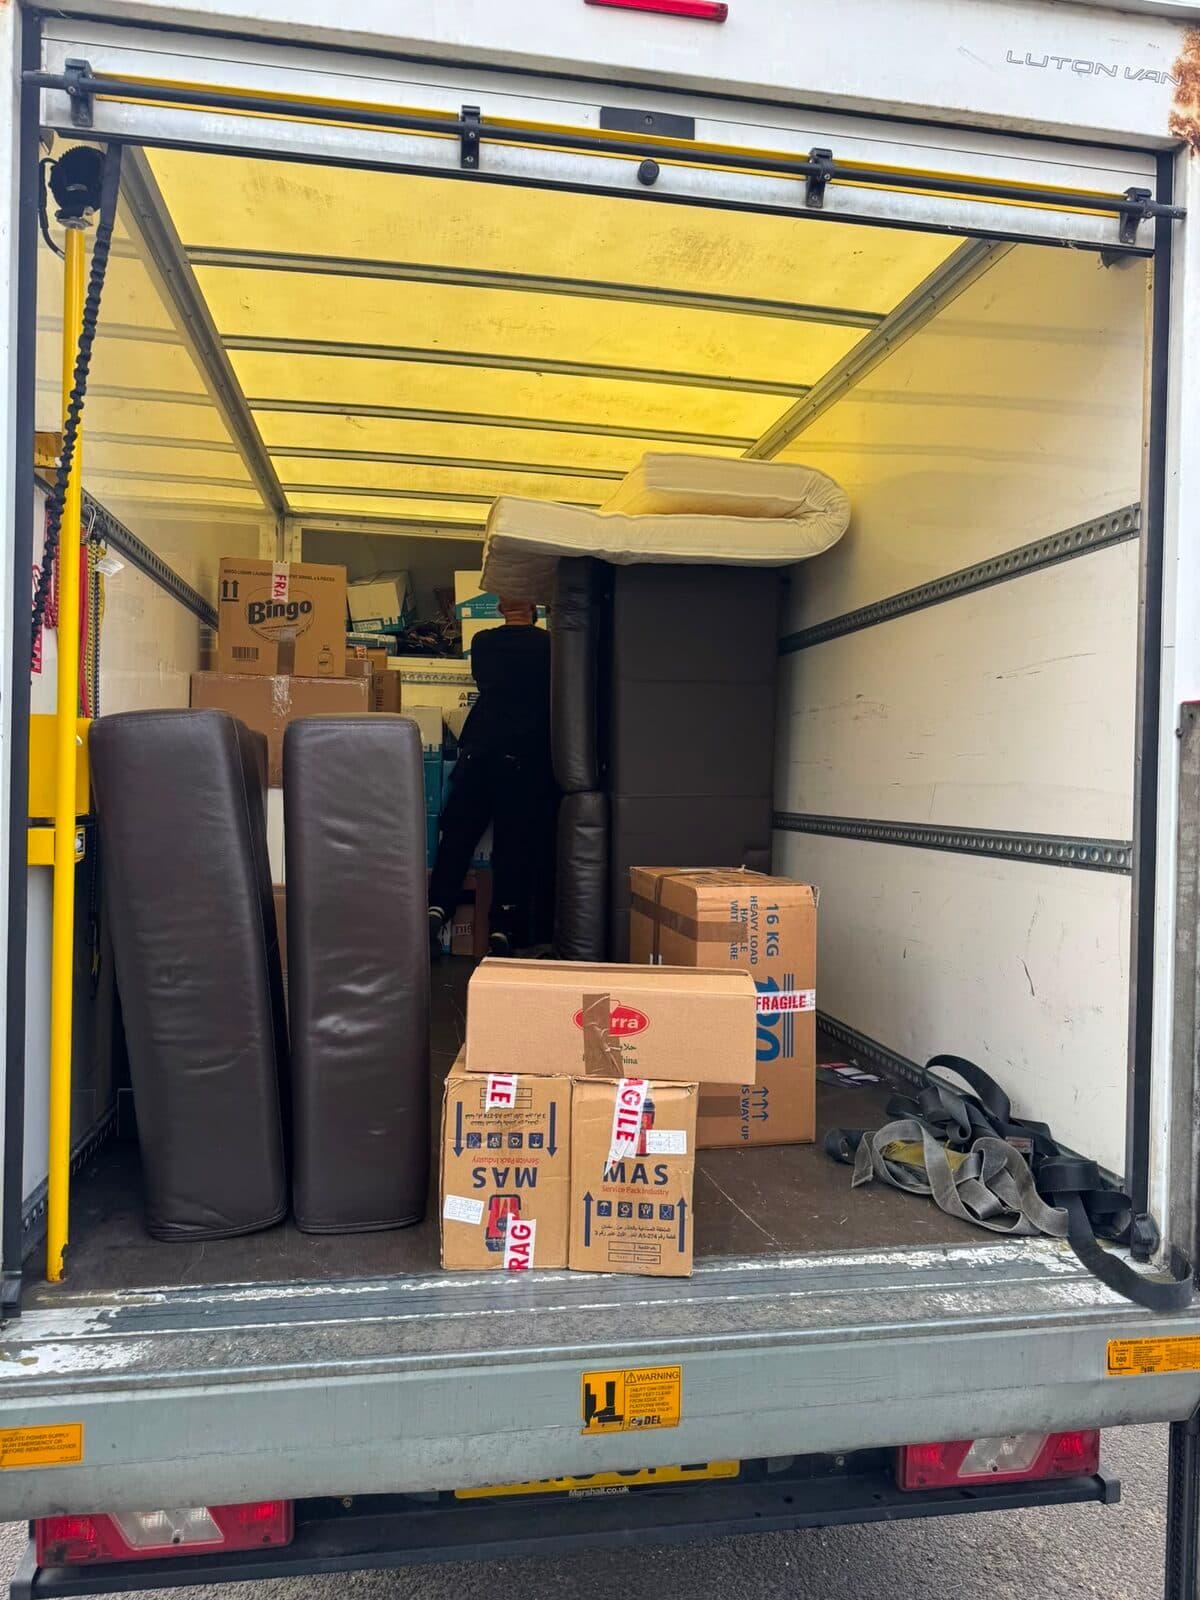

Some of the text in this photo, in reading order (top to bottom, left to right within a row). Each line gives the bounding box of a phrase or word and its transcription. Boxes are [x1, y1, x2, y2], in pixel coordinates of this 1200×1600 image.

[1006, 50, 1183, 87] LUTON VAN
[274, 574, 287, 598] FRA
[248, 600, 312, 625] Bingo
[730, 900, 738, 923] WIT
[750, 895, 758, 965] HEAVY LOAD
[766, 903, 779, 958] 16 KG
[756, 994, 806, 1012] FRAGILE
[740, 1096, 750, 1122] WAY
[740, 1126, 749, 1140] UP
[472, 1156, 499, 1164] Industry
[515, 1157, 540, 1165] Service
[472, 1167, 538, 1188] MAS
[603, 1161, 668, 1186] MAS
[602, 1186, 626, 1194] Service
[642, 1188, 669, 1196] Industry
[508, 1224, 532, 1270] RAG
[636, 1372, 679, 1382] WARNING
[644, 1415, 662, 1425] DEL
[568, 1485, 630, 1498] Marshall.co.uk
